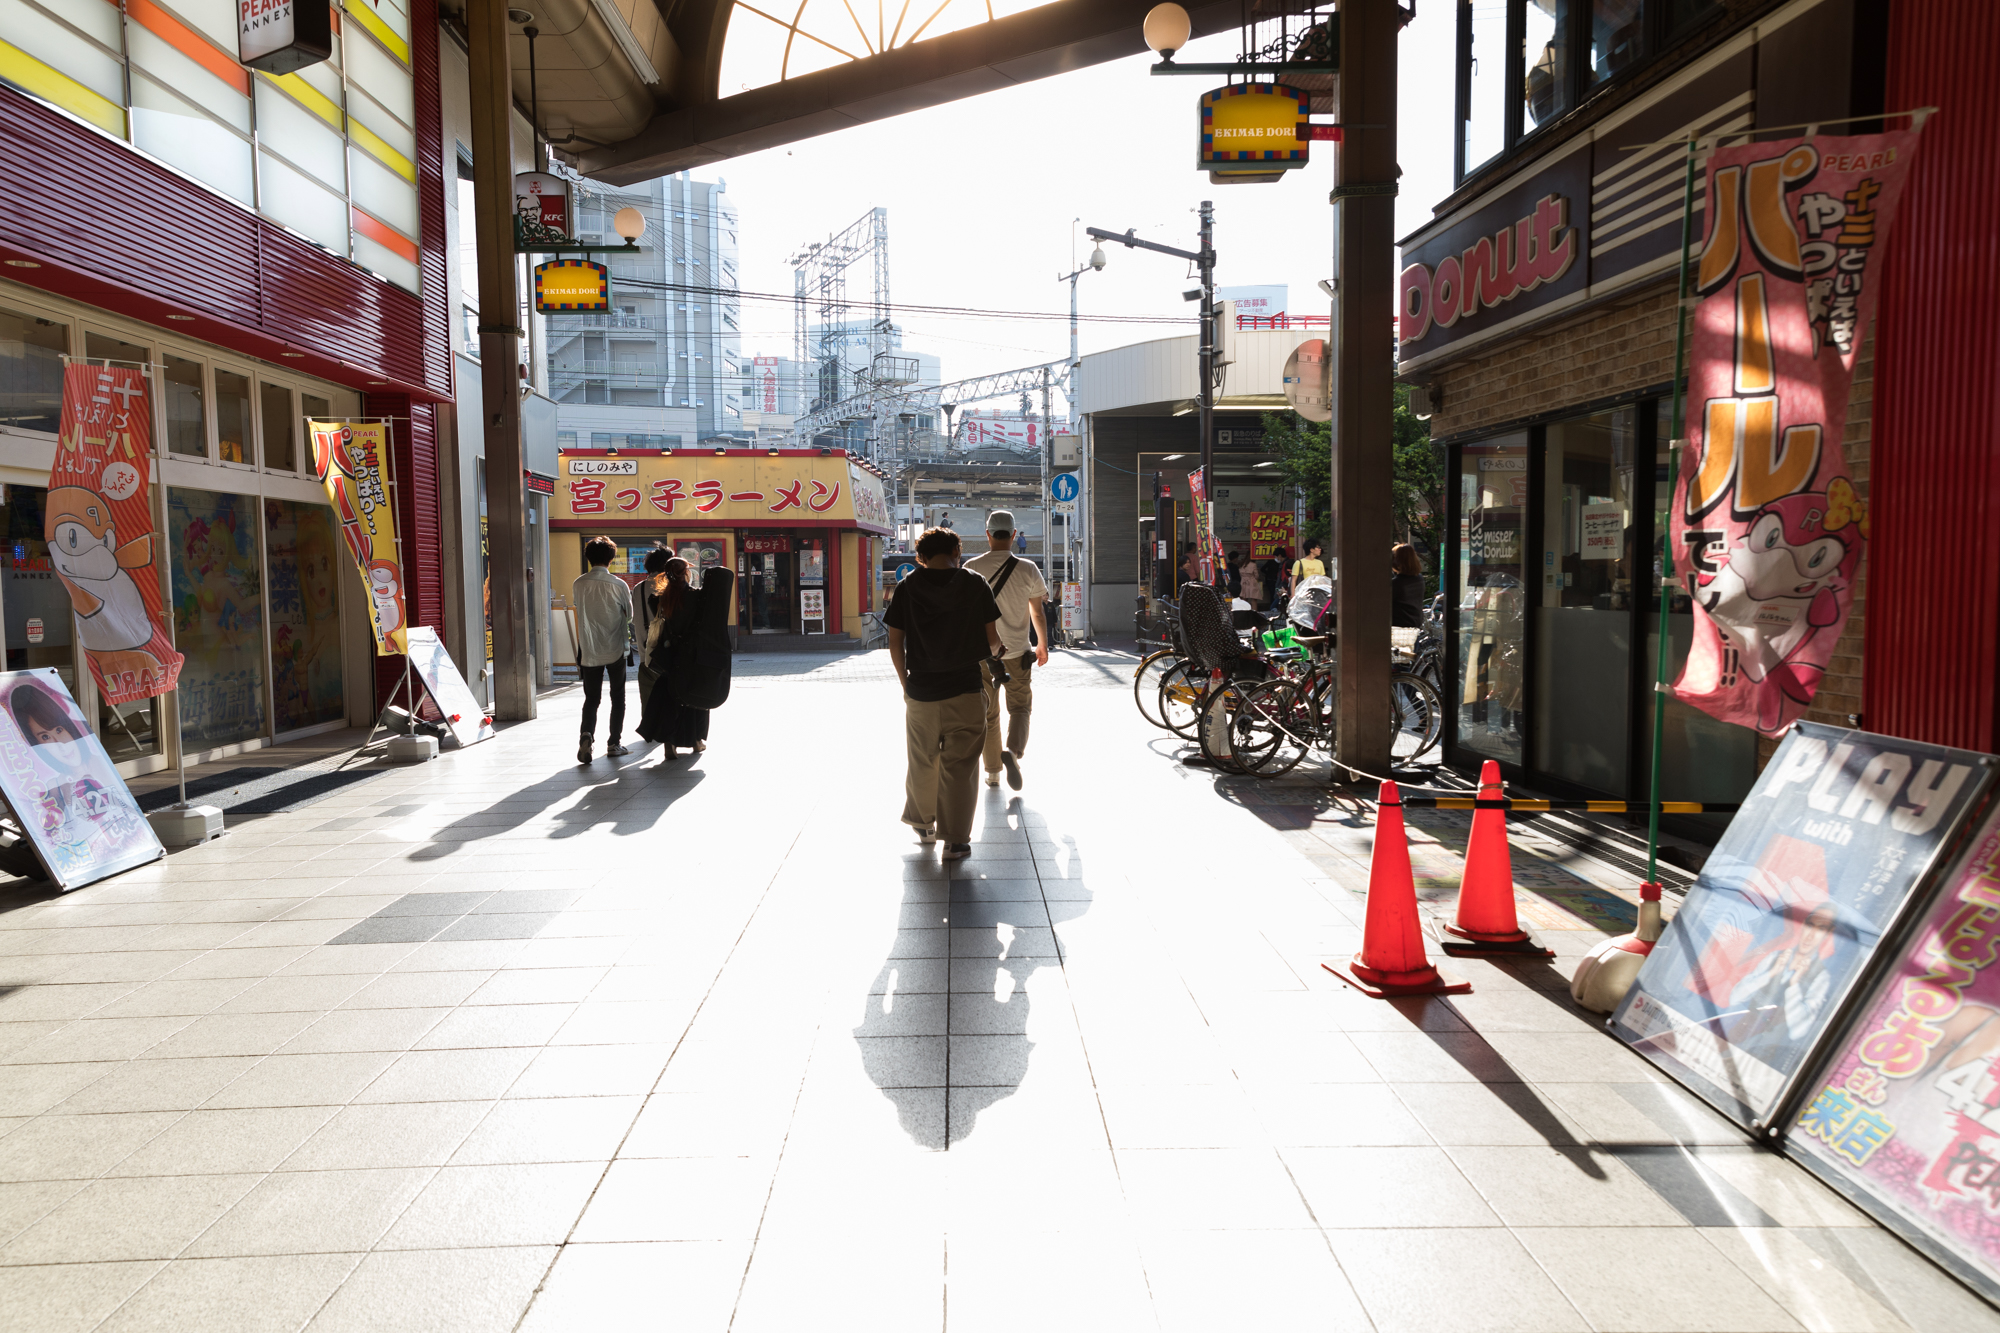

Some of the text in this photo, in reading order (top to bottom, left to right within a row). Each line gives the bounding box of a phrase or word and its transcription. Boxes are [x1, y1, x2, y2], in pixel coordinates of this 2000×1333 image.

[243, 6, 291, 34] ANNEX
[1214, 127, 1296, 138] EKIMAE DORI
[1822, 147, 1898, 173] PEARL
[543, 213, 565, 222] KFC
[578, 287, 599, 295] DORI
[1235, 298, 1268, 309] 広告募集
[1683, 143, 1824, 526] パール
[763, 367, 777, 414] 入居者募集
[353, 429, 379, 437] PEARL
[573, 461, 634, 474] にしのみや
[569, 477, 842, 515] 宮っ子ラーメン
[1484, 530, 1514, 544] mister
[12, 558, 52, 572] PEARL
[1483, 545, 1514, 559] Donut
[1074, 585, 1082, 615] 降雨時の
[1763, 735, 1973, 837] PLAY
[1802, 818, 1855, 847] with
[1846, 1066, 1889, 1107] さん
[1797, 1083, 1896, 1168] 来店
